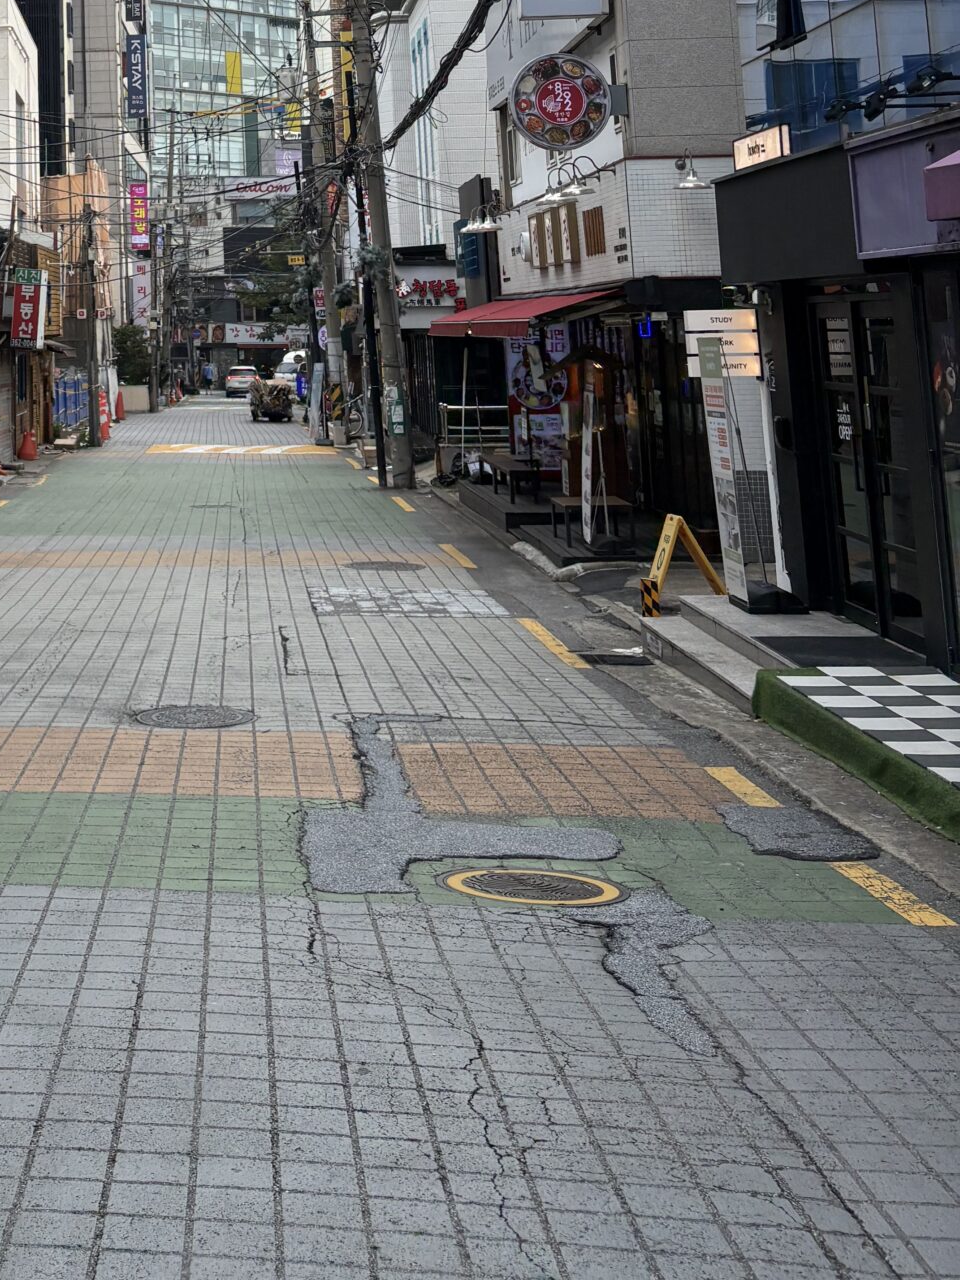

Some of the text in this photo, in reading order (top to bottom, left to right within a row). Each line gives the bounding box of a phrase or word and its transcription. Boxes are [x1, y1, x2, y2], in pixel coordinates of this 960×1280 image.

[17, 271, 41, 283] 신진
[18, 284, 35, 339] 부동산
[709, 316, 733, 324] STUDY
